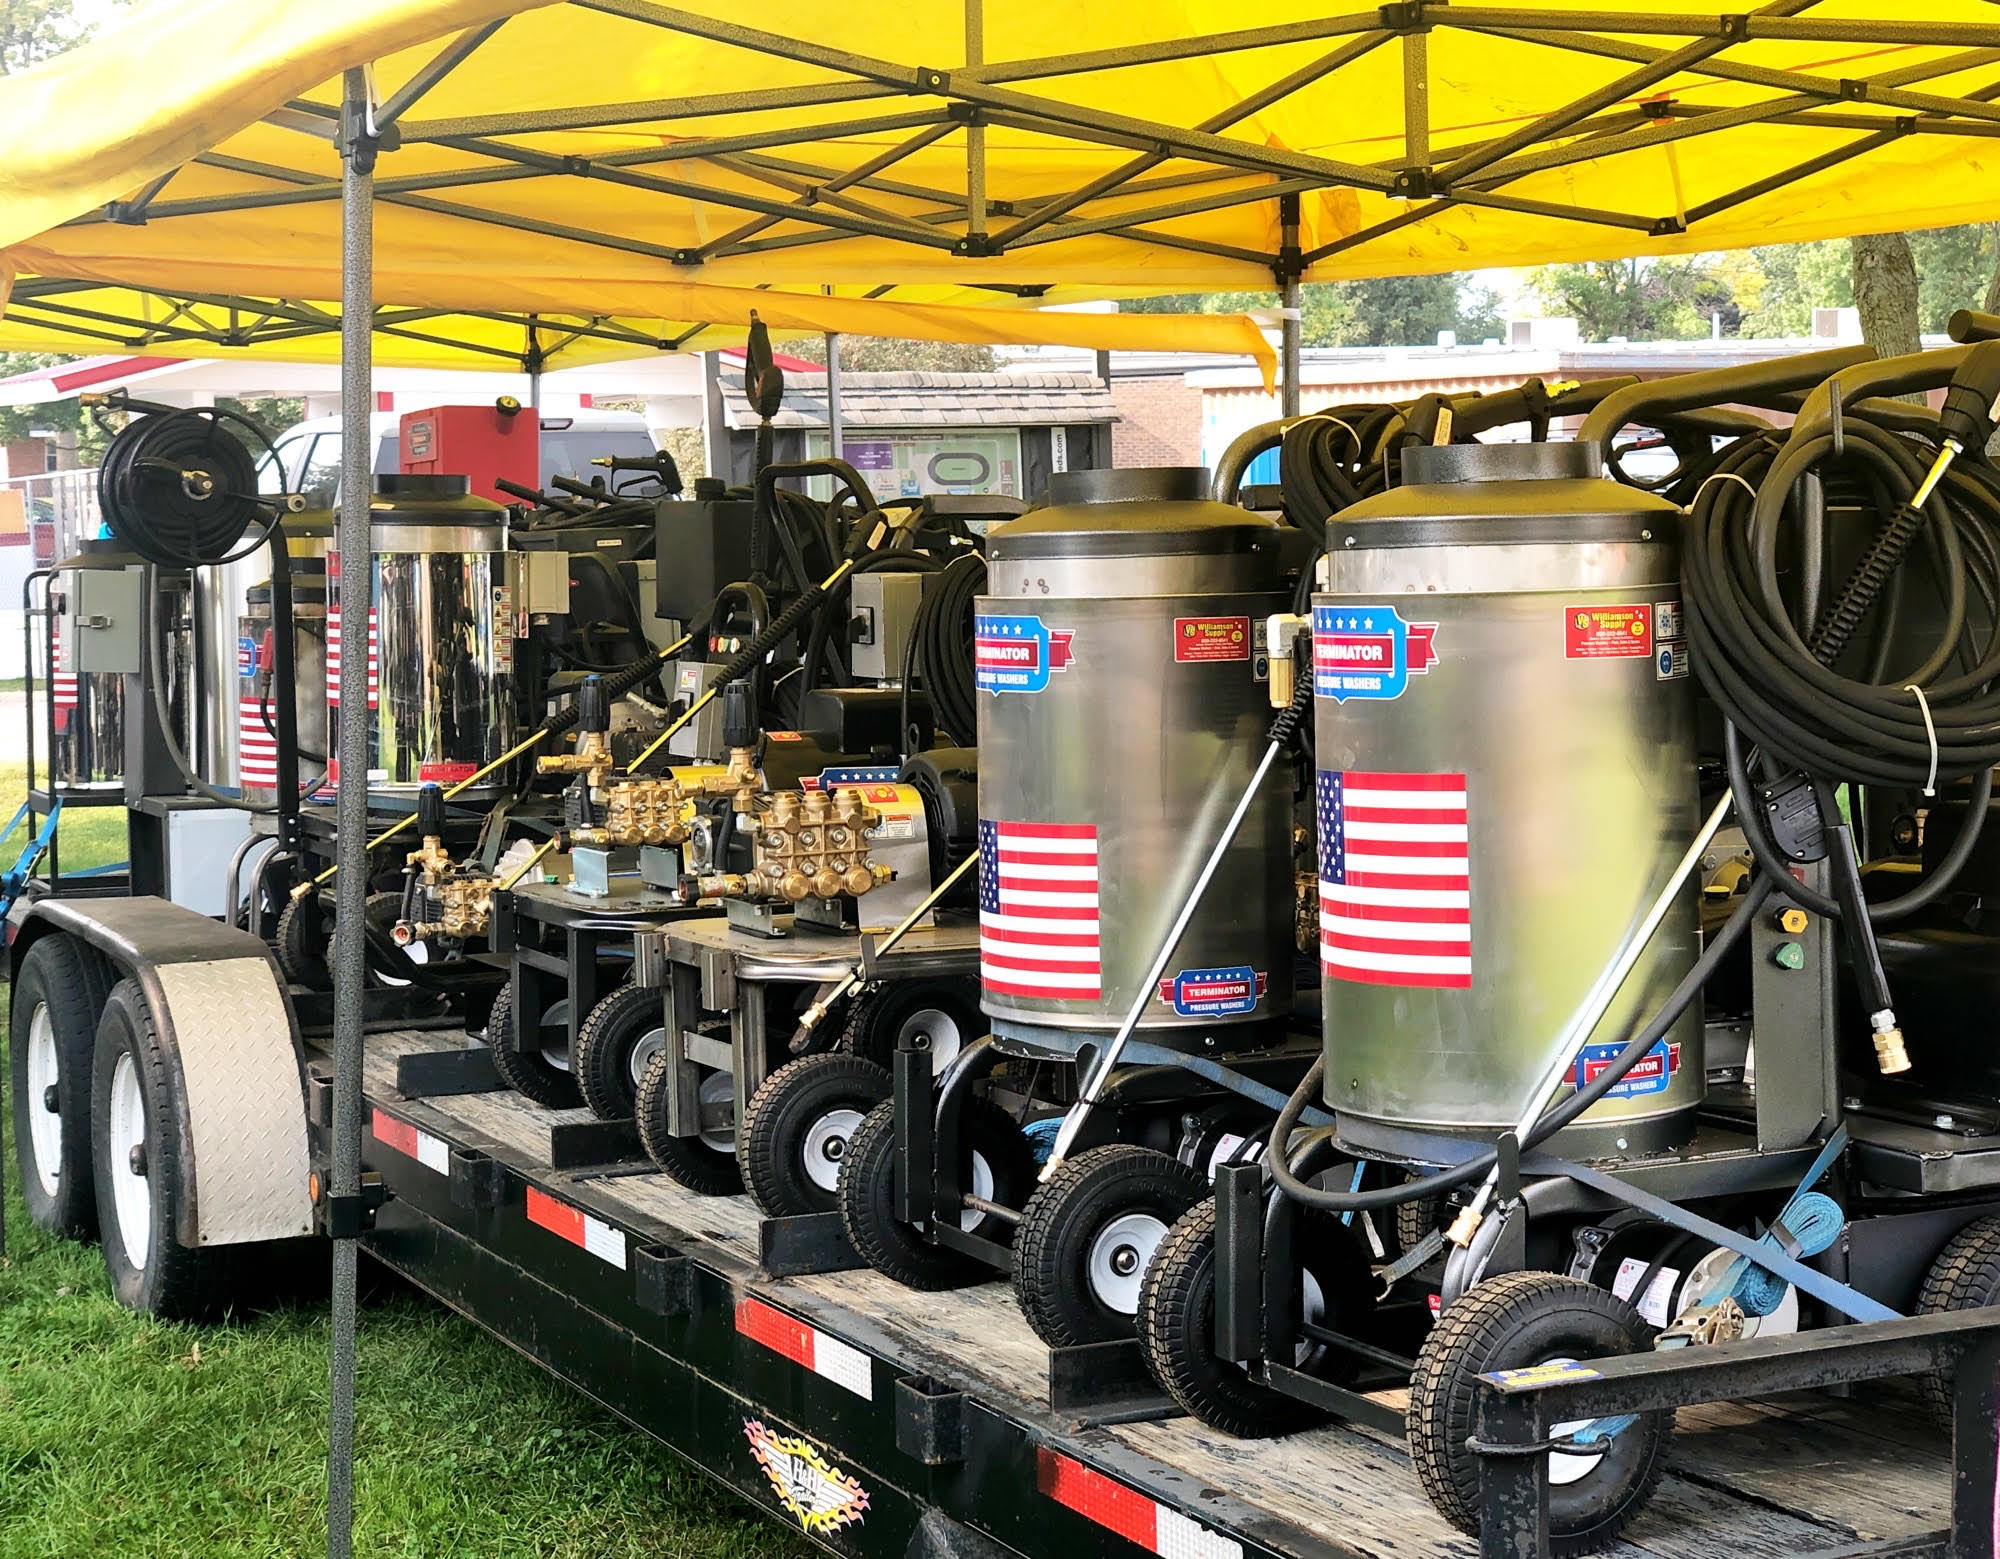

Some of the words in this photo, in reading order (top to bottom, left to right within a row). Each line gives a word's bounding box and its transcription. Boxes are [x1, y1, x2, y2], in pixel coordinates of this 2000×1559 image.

[1591, 612, 1634, 621] Williamson
[1197, 623, 1234, 631] Williamson
[1600, 620, 1626, 629] Supply
[997, 673, 1029, 685] WASHERS
[1342, 676, 1382, 690] WASHERS
[1188, 985, 1246, 997] TERMINATOR
[1189, 1003, 1220, 1012] PRESSURE
[1220, 1001, 1245, 1010] WASHERS
[1592, 1061, 1658, 1076] TATOR
[1606, 1083, 1629, 1094] SURE
[1630, 1080, 1657, 1091] WASHERS
